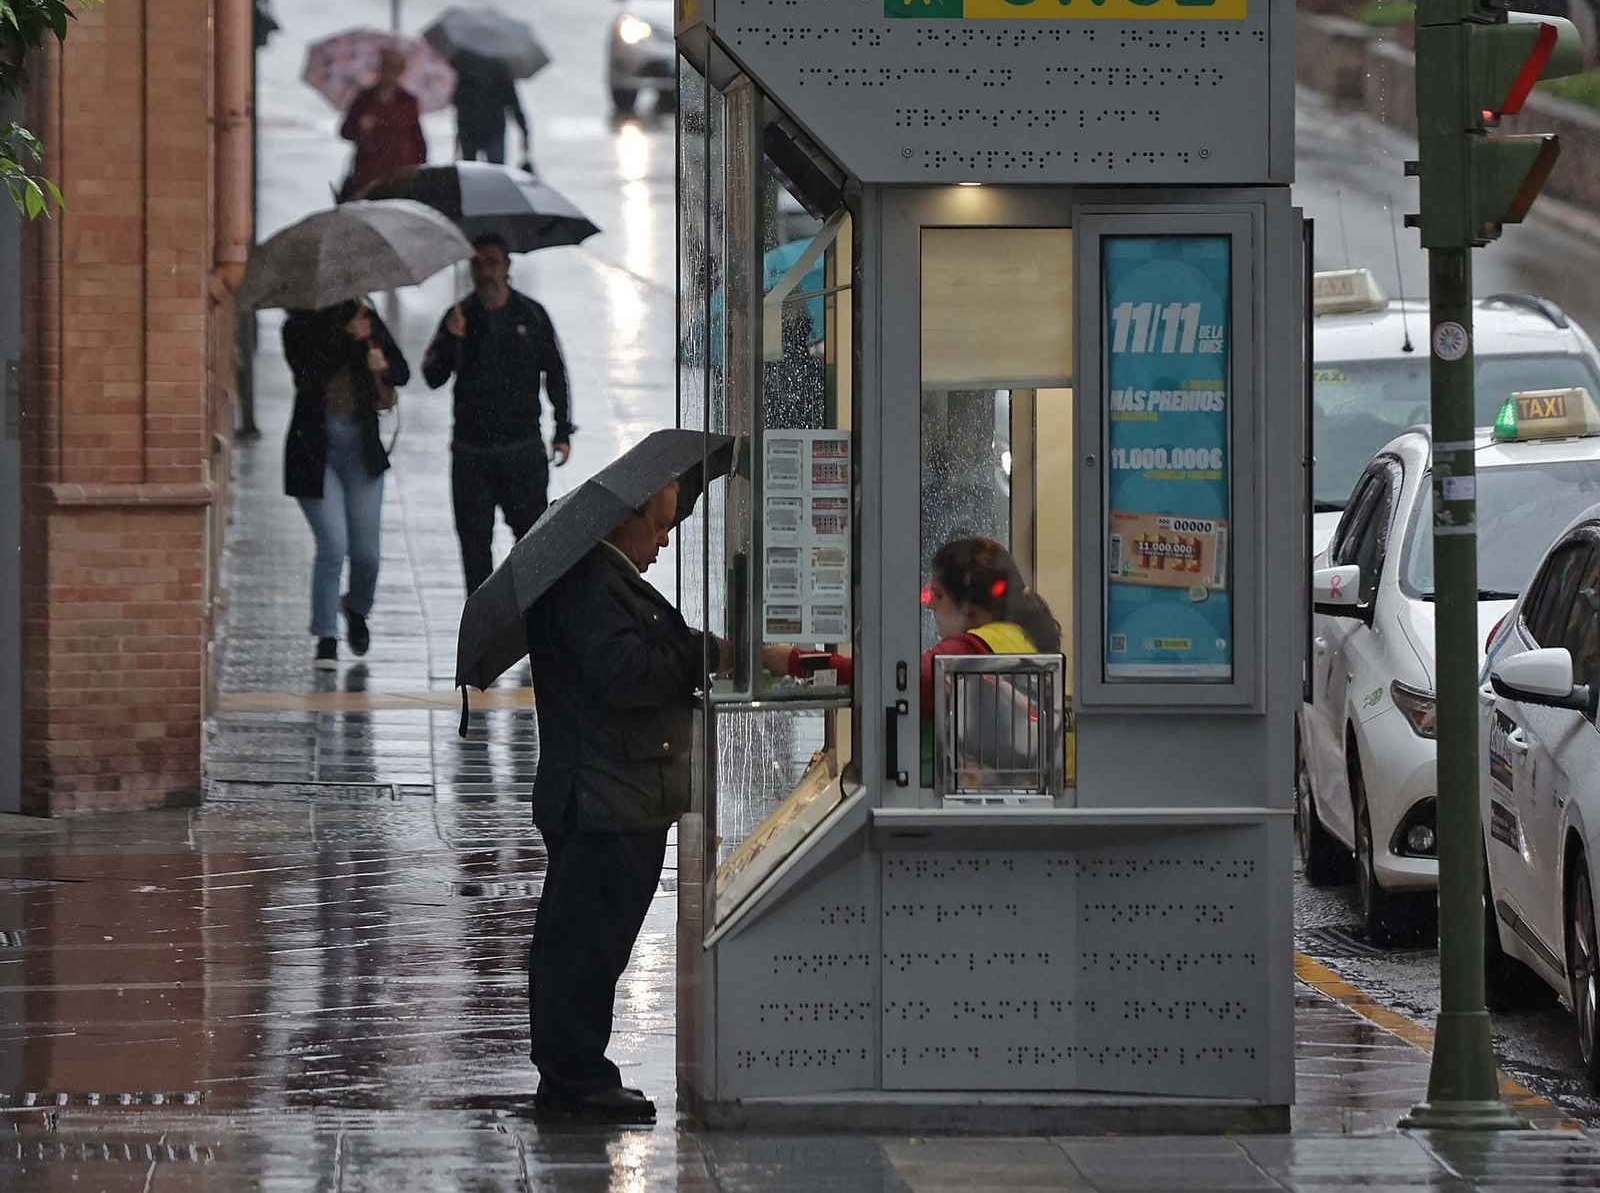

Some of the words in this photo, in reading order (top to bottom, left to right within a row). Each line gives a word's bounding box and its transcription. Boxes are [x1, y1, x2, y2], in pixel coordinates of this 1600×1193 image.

[1112, 301, 1202, 353] 11/11
[1110, 386, 1146, 411] MÁS
[1147, 390, 1226, 412] PREMIOS
[1517, 396, 1565, 419] TAXI
[1111, 447, 1223, 470] 11.000.000€
[1174, 520, 1212, 533] 00000
